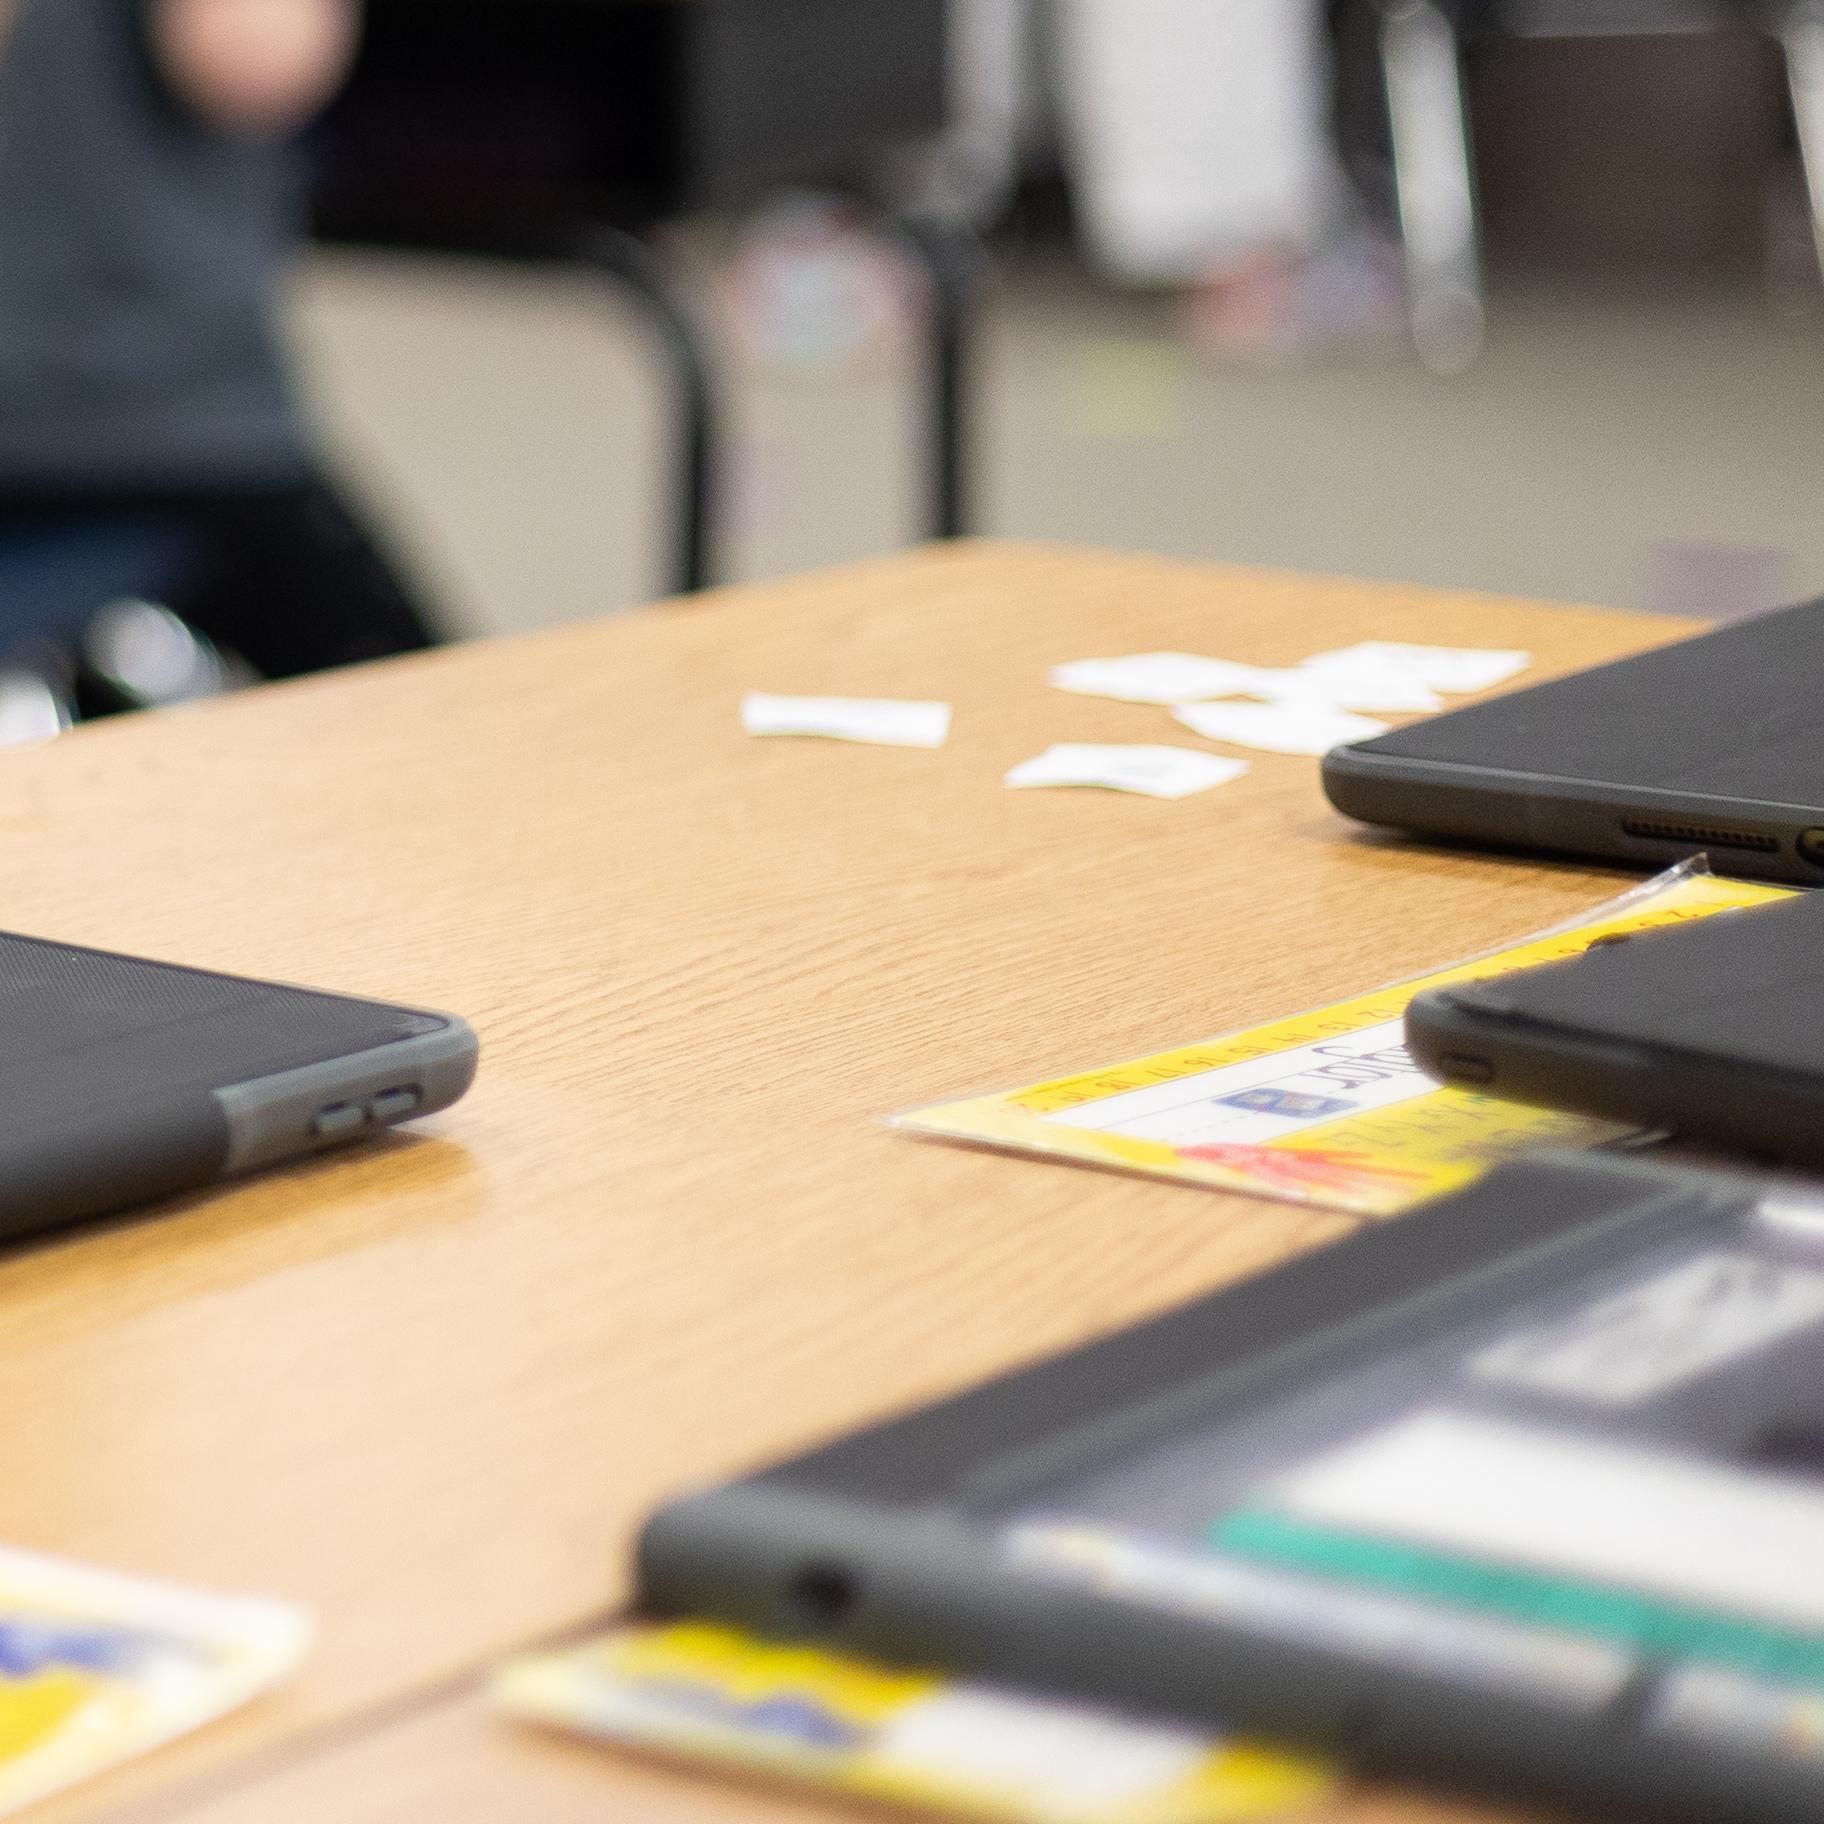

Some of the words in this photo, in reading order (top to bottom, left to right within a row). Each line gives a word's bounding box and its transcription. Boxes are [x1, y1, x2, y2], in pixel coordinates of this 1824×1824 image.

[1357, 1008, 1405, 1019] 12
[1317, 1020, 1363, 1031] 13
[1271, 1032, 1320, 1043] 14
[1228, 1045, 1274, 1056] 15
[1183, 1056, 1232, 1067] 16
[1145, 1067, 1189, 1079] 17
[1095, 1079, 1143, 1091] 18
[1050, 1090, 1096, 1102] 19
